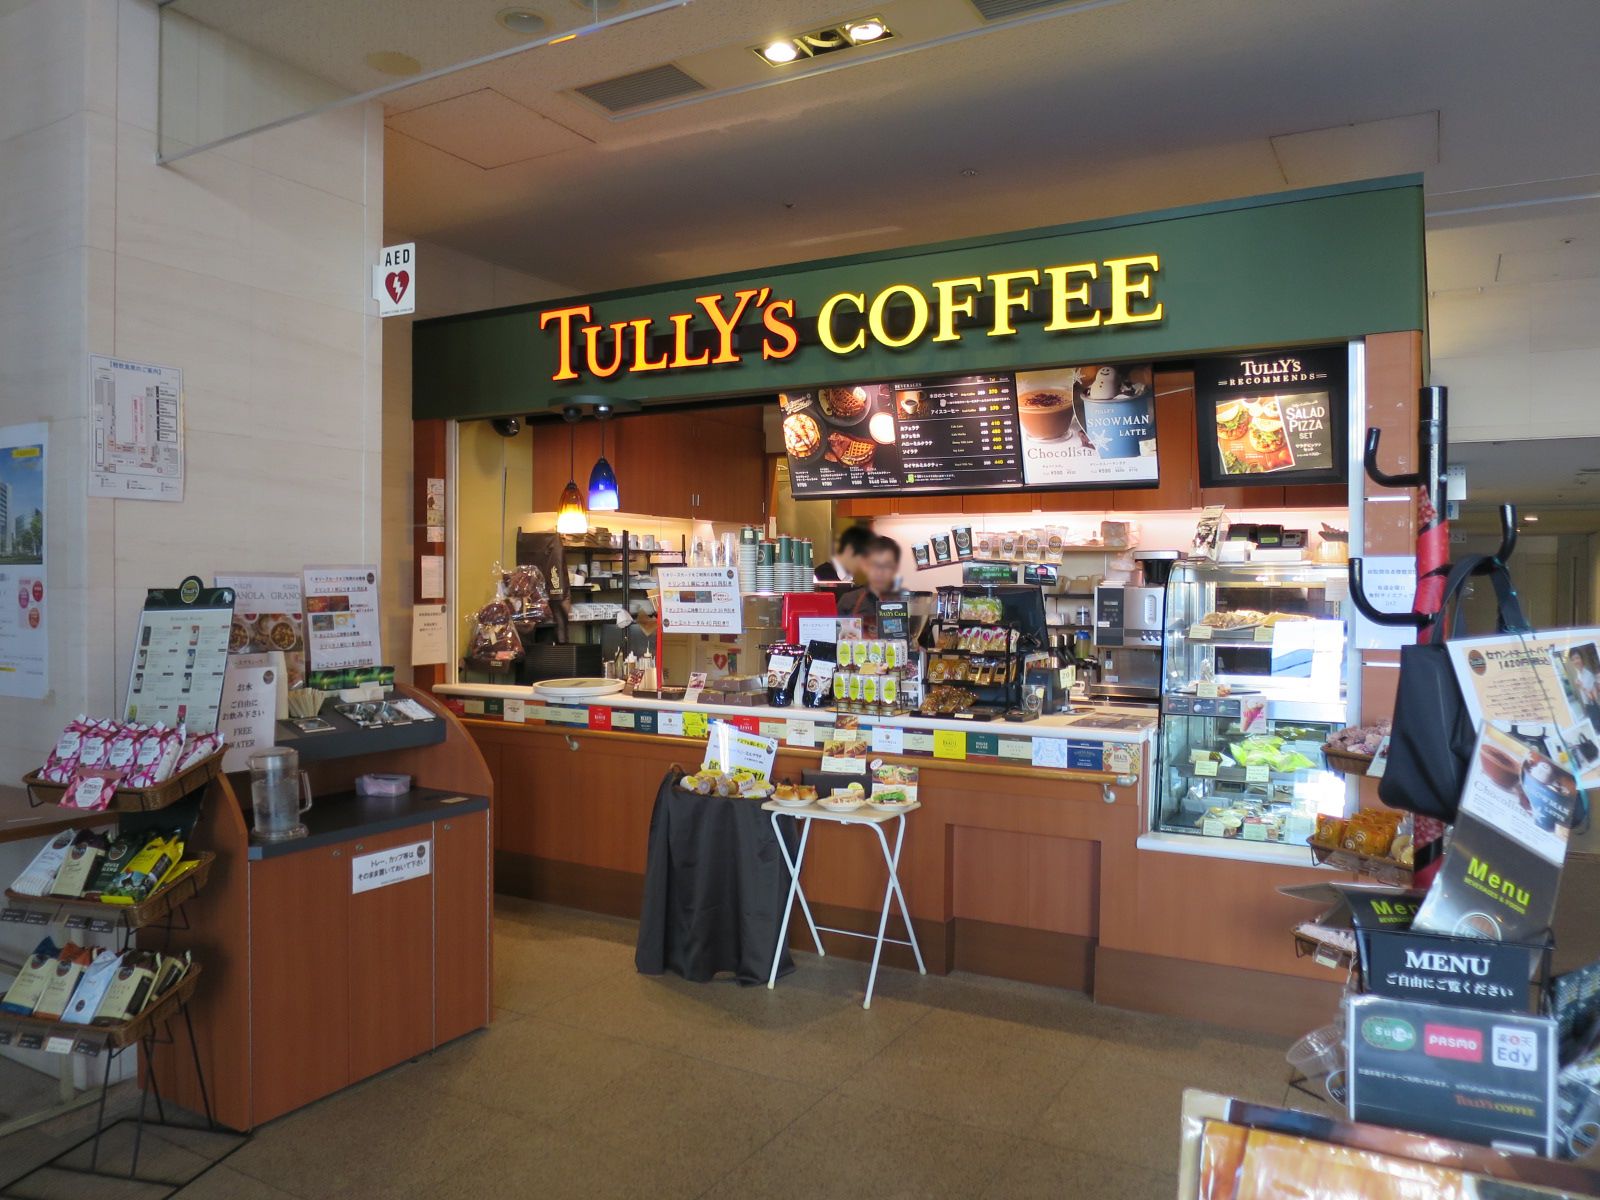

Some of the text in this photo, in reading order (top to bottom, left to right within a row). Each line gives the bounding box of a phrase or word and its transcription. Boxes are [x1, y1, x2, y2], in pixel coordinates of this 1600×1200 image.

[385, 249, 410, 266] AED
[539, 254, 1165, 382] TULLY'S COFFEE
[1240, 358, 1302, 376] TULLY'S
[1230, 373, 1315, 386] RECOMMENDS
[1286, 406, 1325, 420] SALAD
[1087, 414, 1150, 428] SNOWMAN
[1290, 420, 1324, 432] PIZZA
[1120, 428, 1146, 437] LATTE
[1027, 446, 1093, 460] Chocolista
[236, 682, 254, 692] お水
[230, 700, 258, 709] ご自由に
[222, 710, 266, 721] お飲み下さい
[233, 726, 254, 736] FREE
[226, 740, 256, 750] WATER
[358, 860, 426, 881] そのまま置いておいて下さい
[1468, 856, 1531, 906] Menu
[1370, 899, 1420, 916] Men
[1405, 950, 1491, 976] MENU
[1386, 973, 1514, 998] ご自由にご覧ください
[1429, 1032, 1478, 1050] PASMO
[1496, 1046, 1533, 1067] Edy
